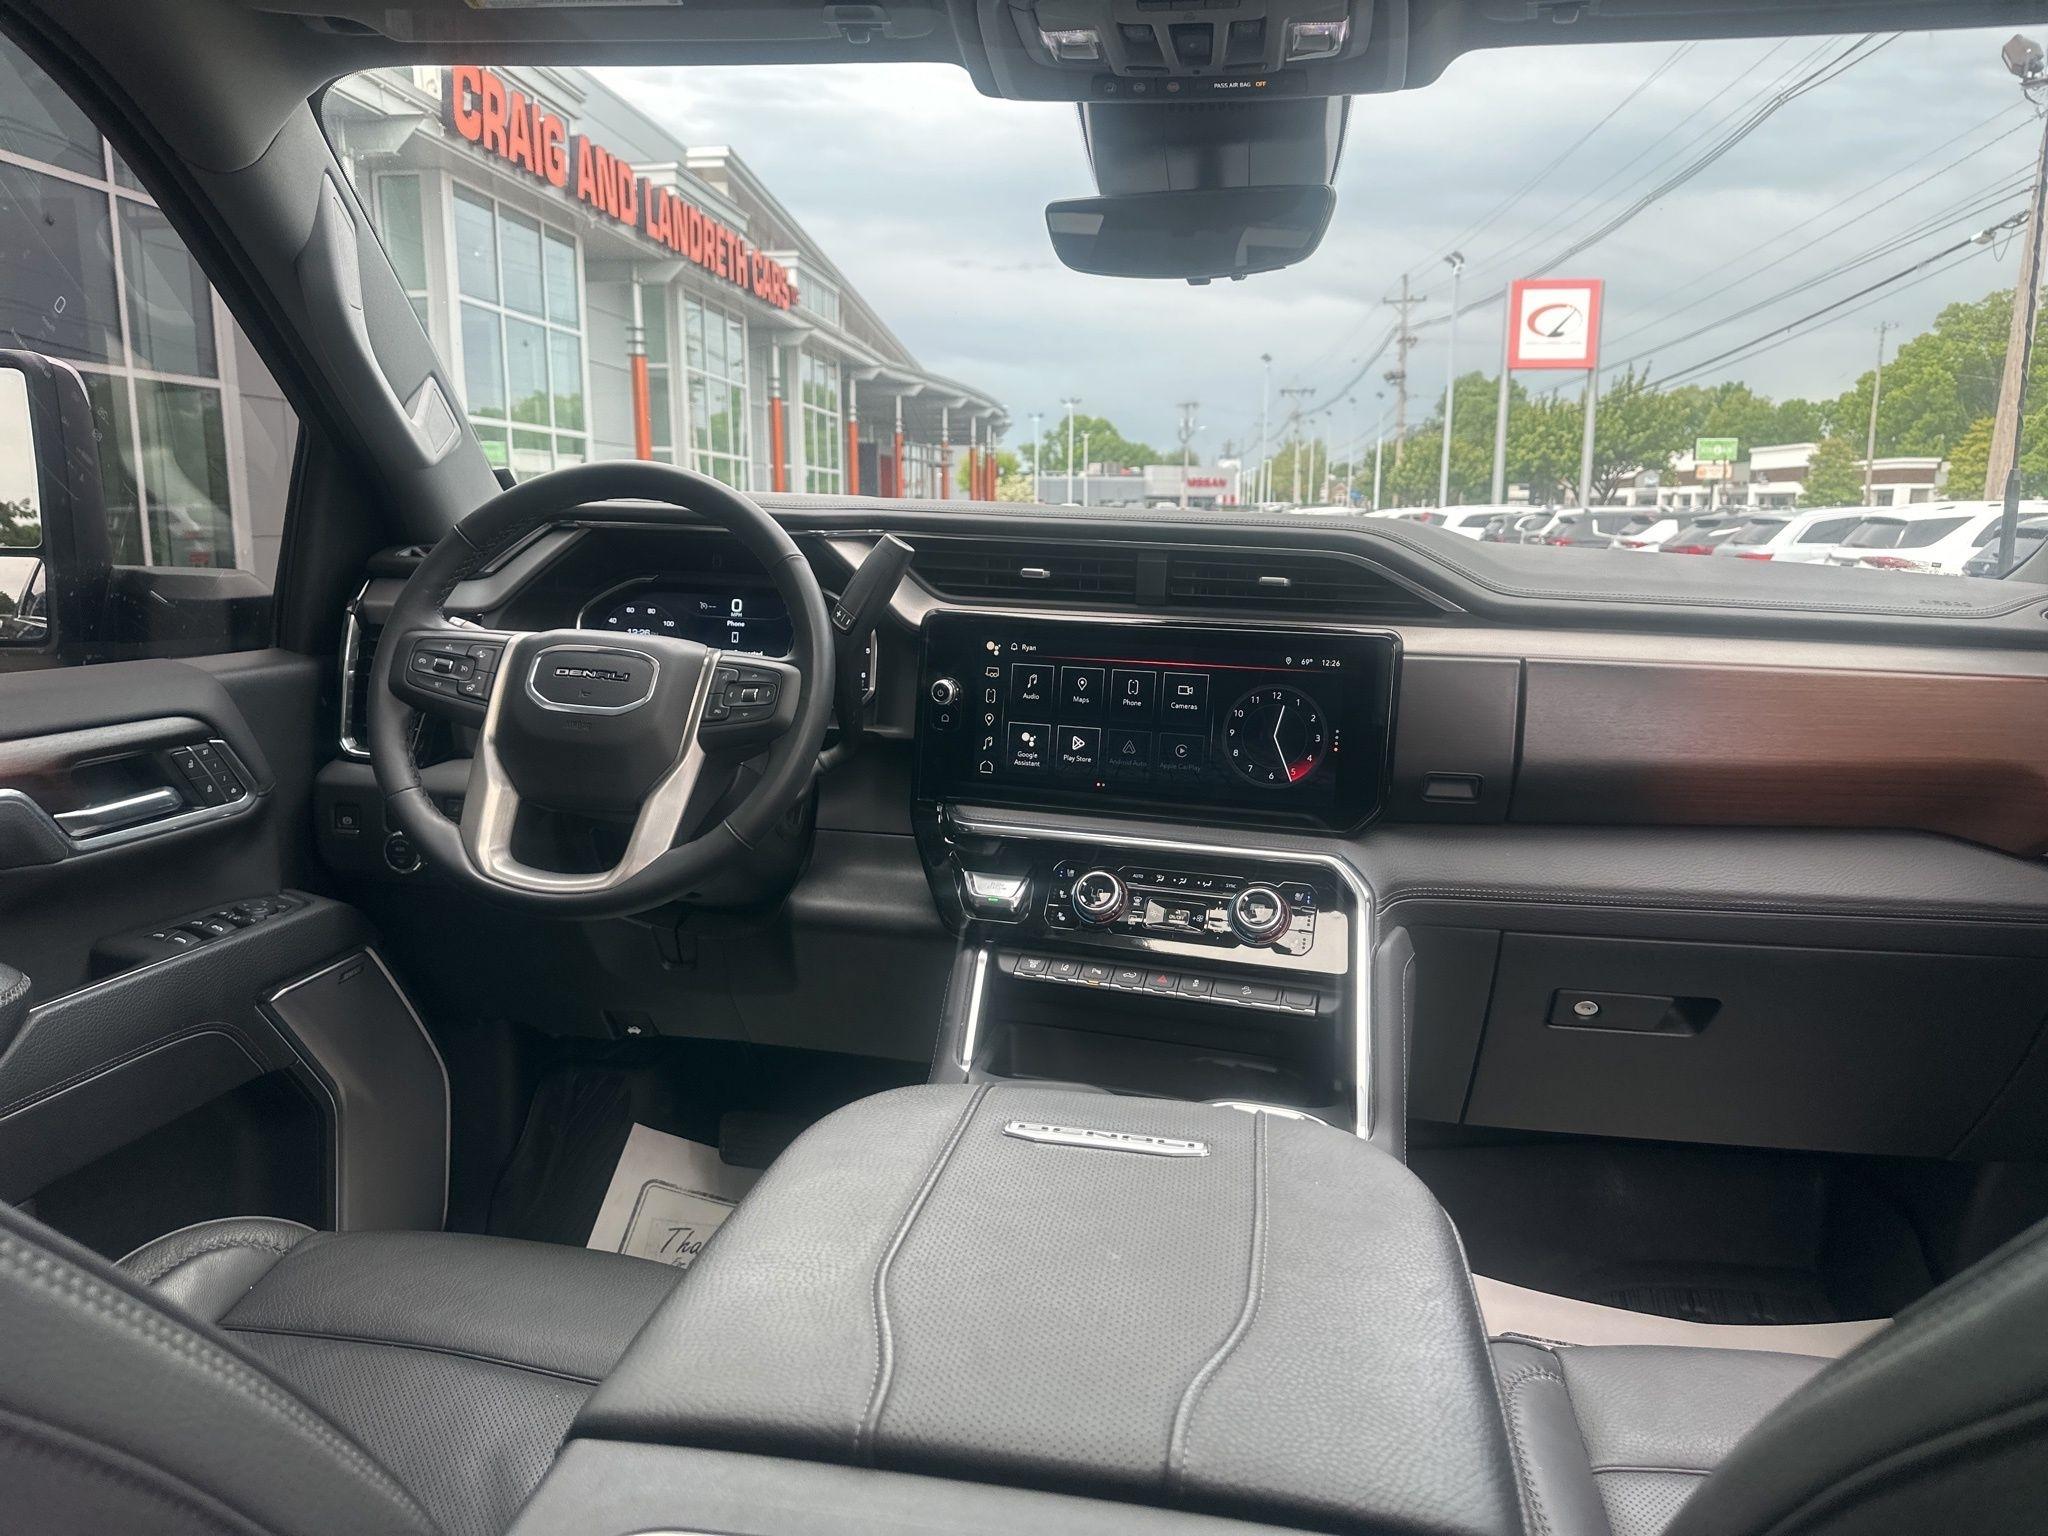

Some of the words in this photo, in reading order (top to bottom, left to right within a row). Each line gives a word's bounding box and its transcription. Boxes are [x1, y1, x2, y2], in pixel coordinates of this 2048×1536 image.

[452, 65, 566, 188] CRAIG
[576, 134, 637, 226] AND
[643, 177, 749, 289] LANDRETH
[752, 250, 790, 311] CARS
[731, 599, 742, 612] 0
[555, 668, 630, 681] DENALI
[1072, 696, 1090, 704] Maps
[1272, 692, 1282, 700] 12
[1170, 702, 1198, 710] Cameras
[1017, 751, 1038, 760] Google
[1013, 759, 1040, 767] Assistant
[660, 1227, 702, 1254] Tha
